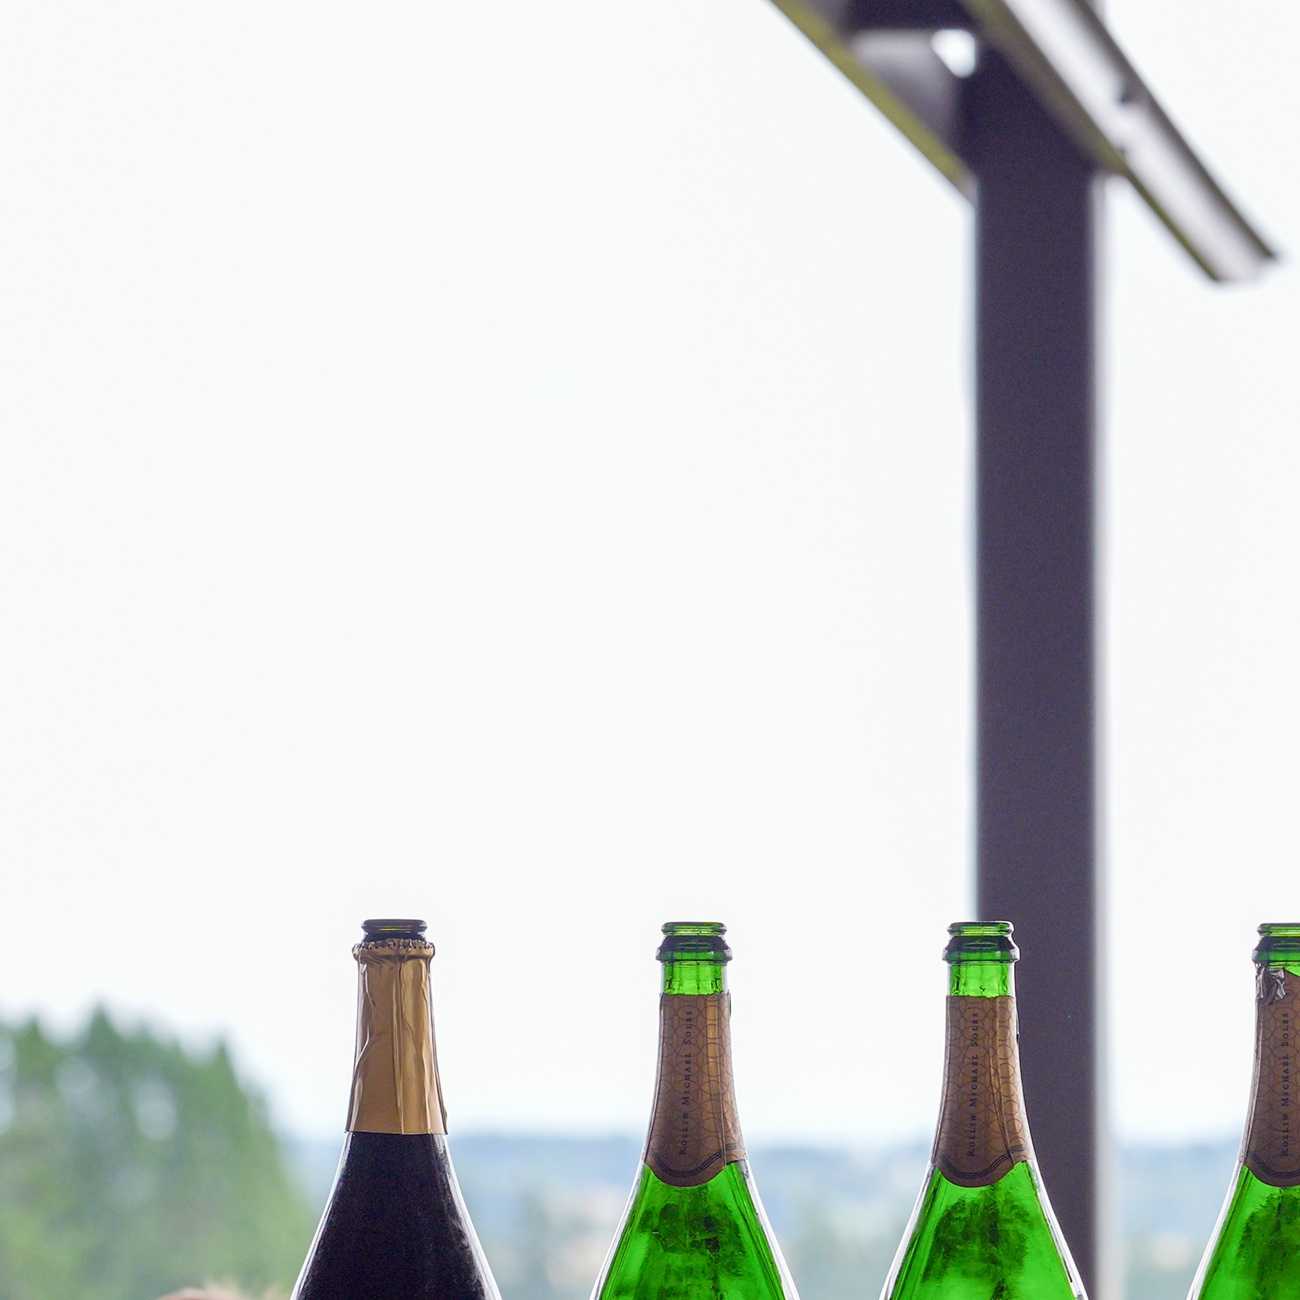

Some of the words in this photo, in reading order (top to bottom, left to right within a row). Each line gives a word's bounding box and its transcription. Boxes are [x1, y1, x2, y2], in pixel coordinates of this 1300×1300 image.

[684, 1011, 692, 1045] SOLES
[682, 1052, 691, 1106] MICHAEL
[970, 1054, 978, 1107] MICHAEL
[679, 1114, 689, 1155] ROLLIN
[968, 1114, 977, 1157] ROLLIN
[1280, 1114, 1289, 1157] ROLLIN
